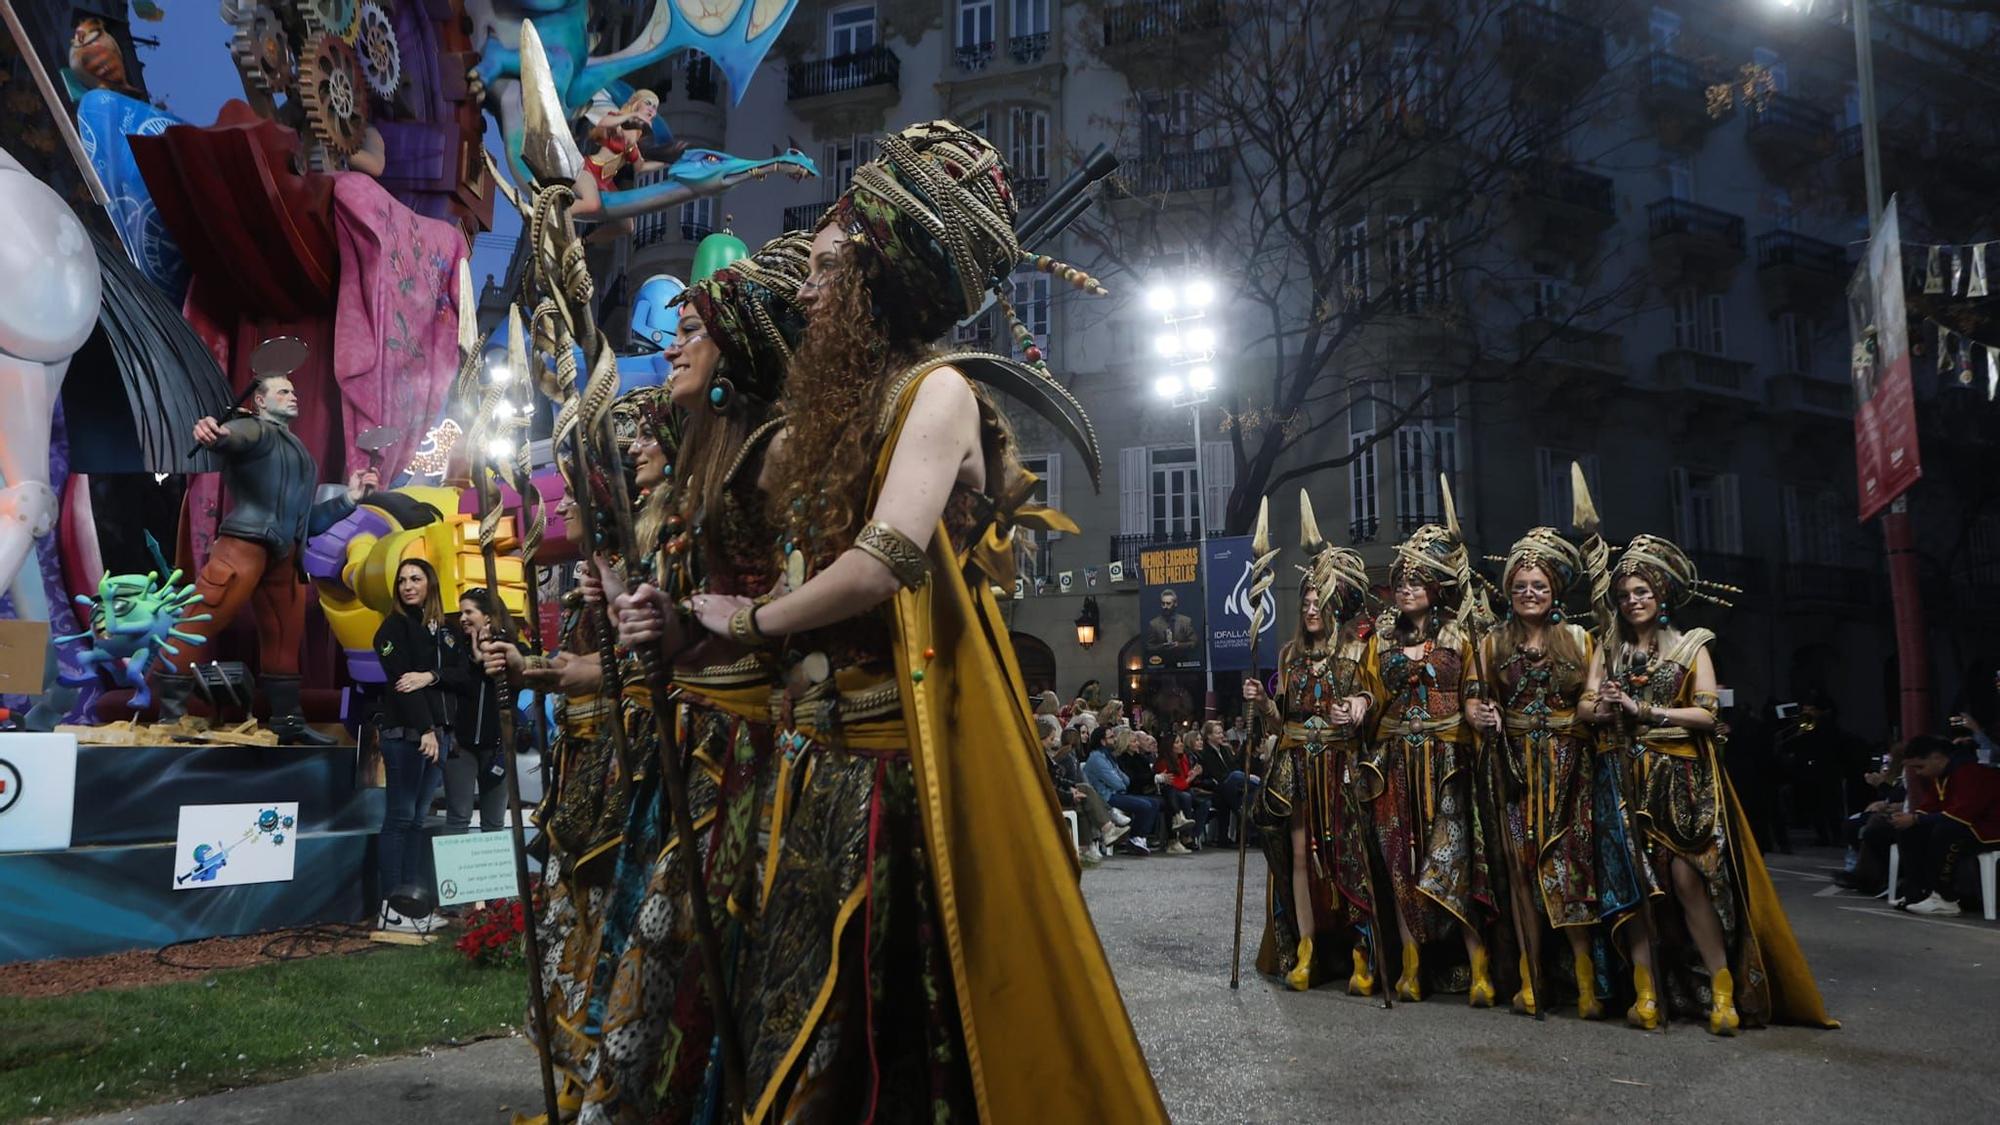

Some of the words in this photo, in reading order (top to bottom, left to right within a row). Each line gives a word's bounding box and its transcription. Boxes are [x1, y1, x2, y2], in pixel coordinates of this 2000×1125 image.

[1141, 550, 1165, 568] MENOS
[1166, 547, 1198, 566] EXCUSAS
[1144, 568, 1149, 586] Y
[1166, 564, 1196, 584] PAELLAS
